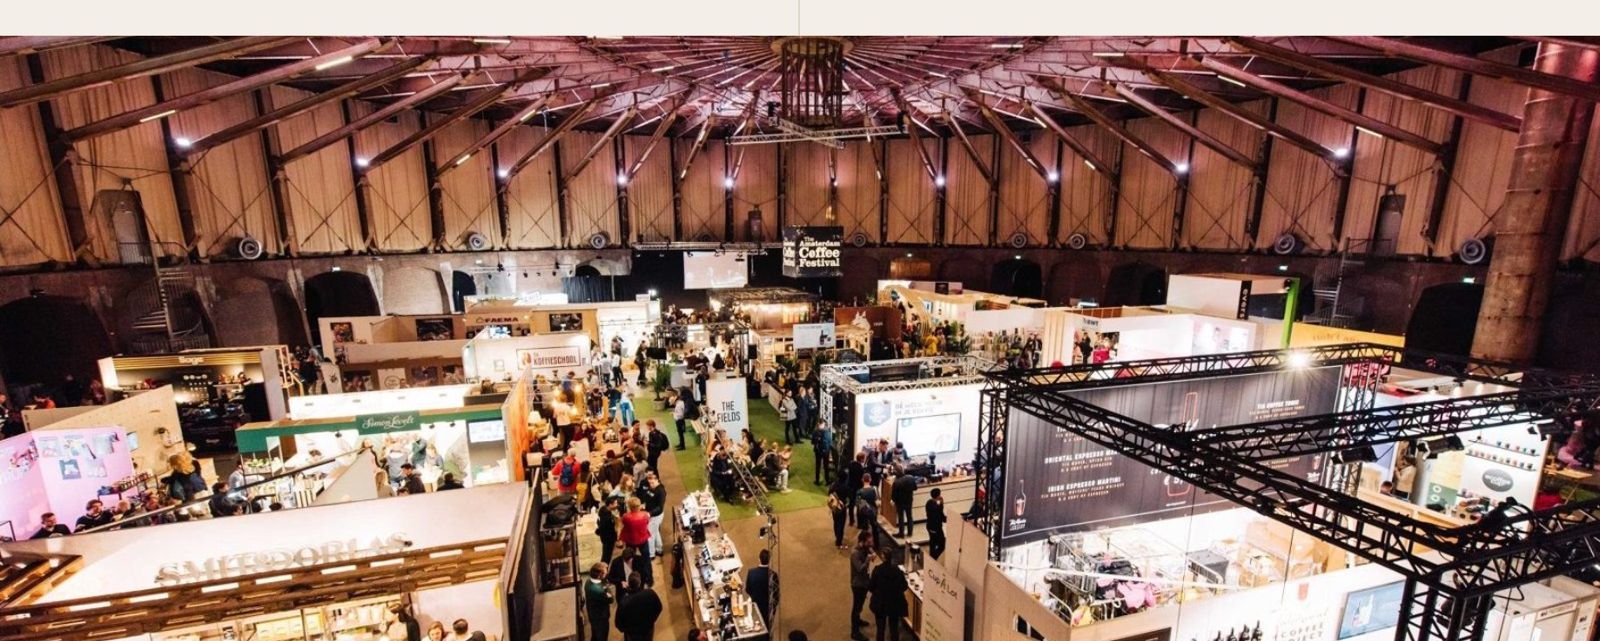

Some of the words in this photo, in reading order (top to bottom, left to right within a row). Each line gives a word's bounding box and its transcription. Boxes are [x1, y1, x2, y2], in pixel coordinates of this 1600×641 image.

[799, 247, 840, 258] Coffee
[799, 258, 840, 267] Festival
[721, 400, 735, 411] THE
[716, 411, 741, 422] FIELDS
[1044, 454, 1073, 465] ORIENTAL
[1074, 450, 1105, 460] ESPRESSO
[1047, 484, 1065, 493] IRISH
[1066, 479, 1096, 491] ESPRESSO
[1097, 476, 1122, 486] MARTINI
[1281, 621, 1324, 639] COFFEE
